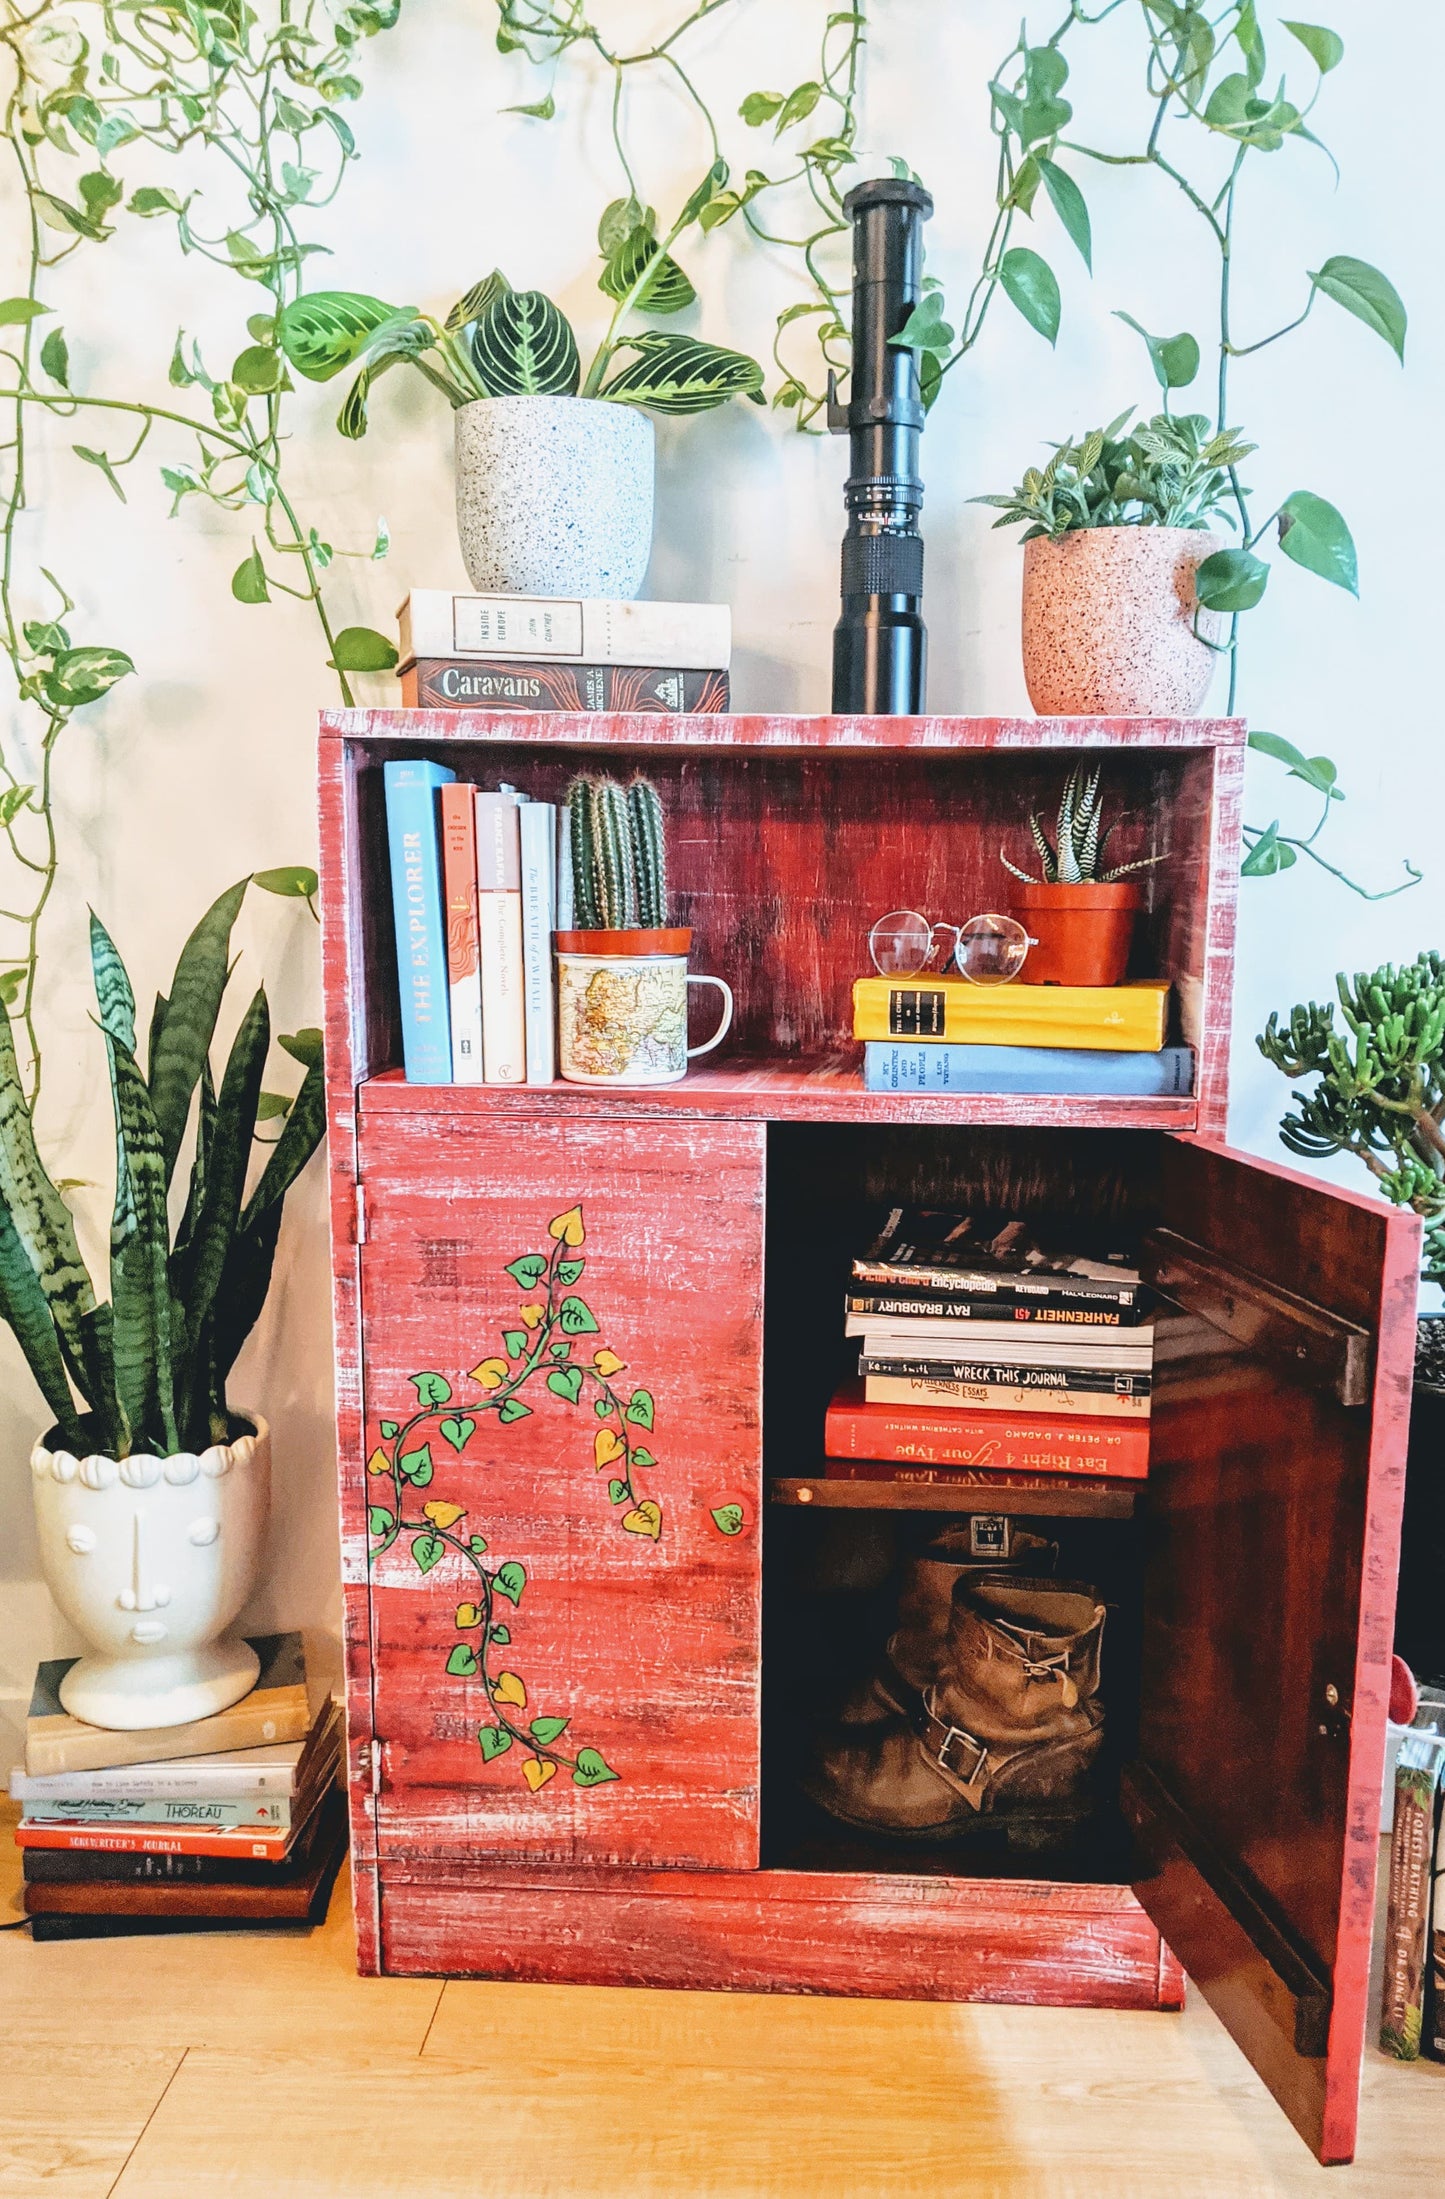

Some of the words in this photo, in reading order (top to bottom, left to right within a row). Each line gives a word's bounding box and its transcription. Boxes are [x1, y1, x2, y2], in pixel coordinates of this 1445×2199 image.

[480, 609, 489, 640] INSIDE
[497, 610, 506, 640] EUROPE
[528, 617, 537, 636] JOHN
[442, 667, 540, 697] Caravans
[587, 680, 596, 710] JAMES
[494, 807, 503, 845] FRANZ
[496, 847, 505, 885] KAFKA
[528, 867, 538, 882] The
[403, 831, 430, 967] EXPLORER
[497, 899, 506, 913] The
[529, 886, 540, 940] BREATH
[497, 919, 509, 961] Complete
[529, 944, 540, 956] of
[499, 965, 509, 996] Novels
[532, 964, 541, 1013] WHALE
[412, 974, 432, 1024] THE
[883, 1061, 889, 1076] MY
[891, 1049, 899, 1088] COUNTRY
[910, 1061, 916, 1076] MY
[918, 1051, 926, 1086] PEOPLE
[931, 1274, 997, 1292] Encyclopedia
[877, 1300, 943, 1315] BRADBURY
[946, 1304, 971, 1317] RAY
[1014, 1308, 1031, 1320] 451
[1034, 1309, 1120, 1325] FAHRENHEIT
[868, 1361, 892, 1372] Keri
[902, 1363, 929, 1375] Smith
[953, 1365, 990, 1381] WRECK
[993, 1368, 1020, 1383] THIS
[1022, 1372, 1069, 1387] JOURNAL
[962, 1385, 988, 1398] ESSAYS
[885, 1423, 919, 1431] WHITNEY
[921, 1425, 962, 1434] CATHERINE
[1005, 1430, 1052, 1441] D'ADAMO
[1056, 1433, 1064, 1441] J.
[1067, 1434, 1100, 1444] PETER
[1104, 1436, 1121, 1445] DR.
[896, 1444, 937, 1461] Type
[942, 1439, 1002, 1466] Your
[1006, 1452, 1015, 1465] 4
[1022, 1452, 1071, 1469] Right
[1077, 1456, 1108, 1473] Eat
[165, 1803, 223, 1819] THOREAU
[1411, 1812, 1424, 1858] FOREST
[142, 1839, 183, 1852] JOURNAL
[1407, 1863, 1421, 1918] BATHING
